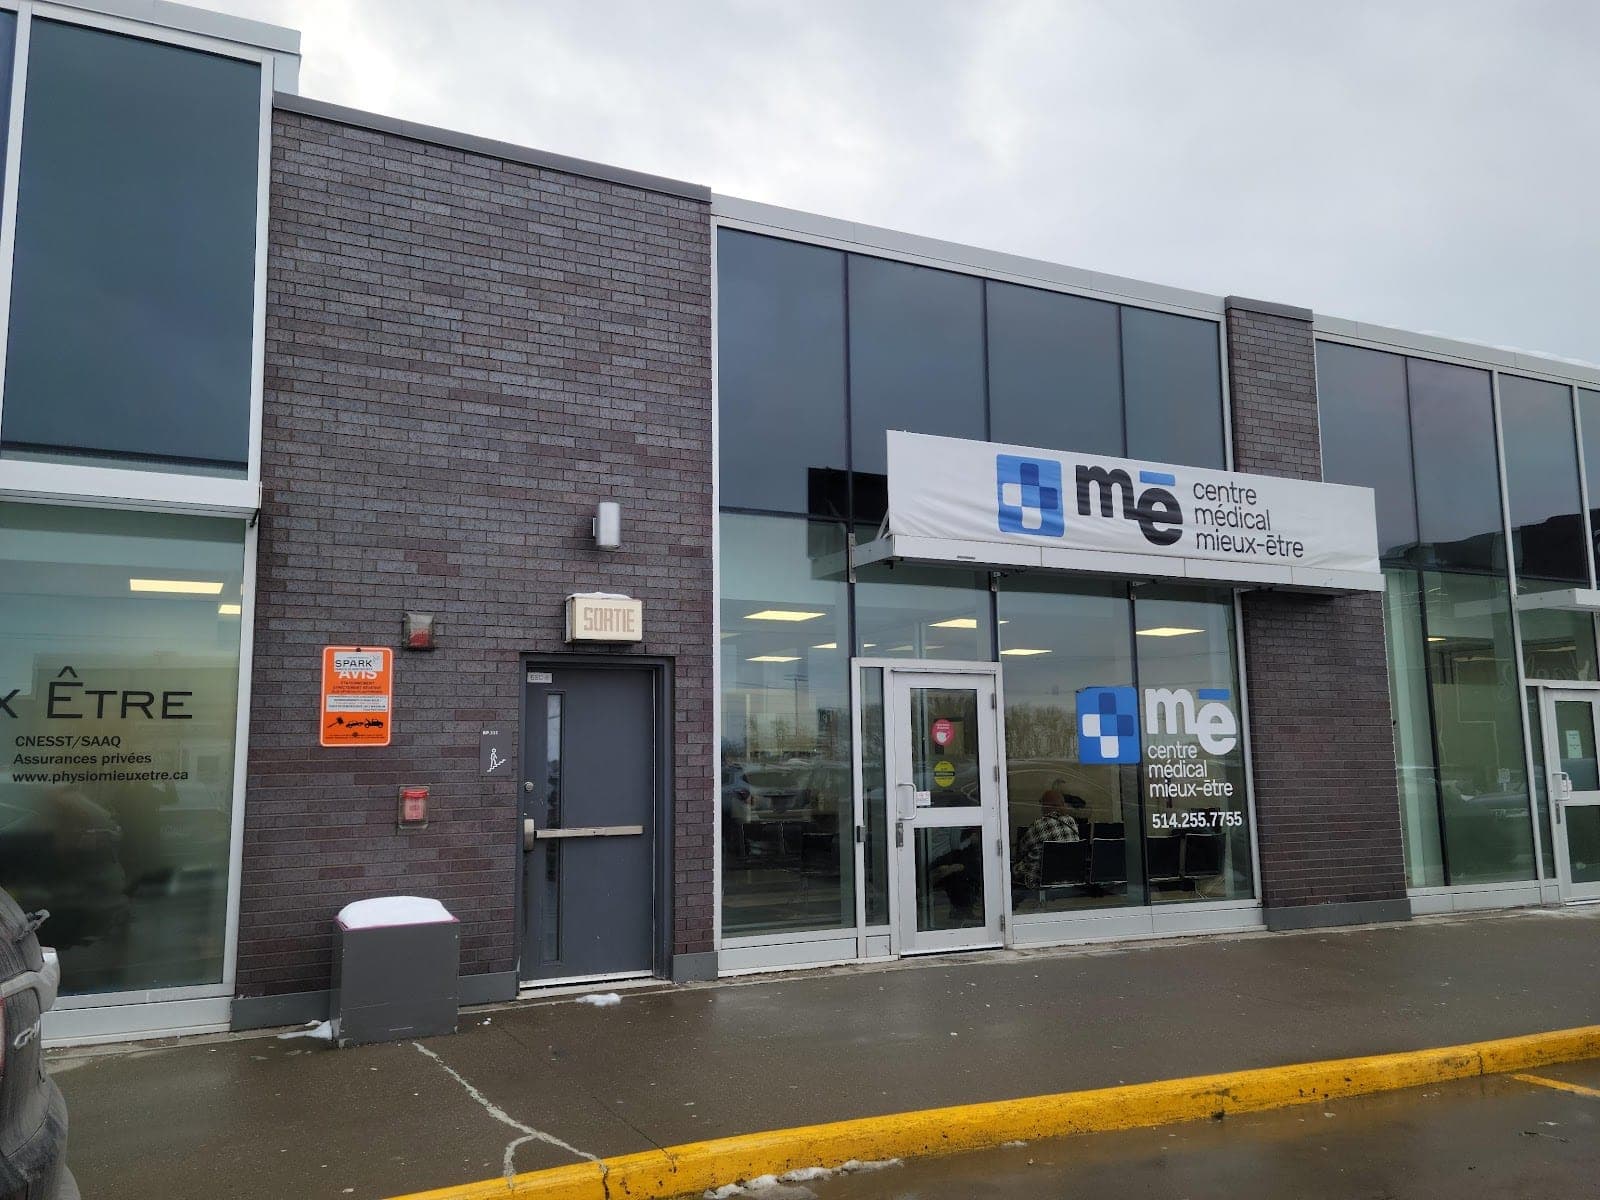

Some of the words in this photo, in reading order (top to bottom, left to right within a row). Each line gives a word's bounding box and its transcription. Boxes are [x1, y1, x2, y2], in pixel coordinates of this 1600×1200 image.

[1193, 481, 1257, 506] centre
[1194, 504, 1271, 532] médical
[583, 606, 635, 632] SORTIE
[335, 659, 372, 668] SPARK
[338, 670, 378, 679] AVIS
[47, 665, 193, 720] ÊTRE
[15, 735, 121, 750] CNESST/SAAQ
[1147, 741, 1198, 759] centre
[13, 753, 97, 765] Assurances
[101, 752, 152, 765] privées
[13, 770, 189, 784] www.physiomieuxetre.ca
[1148, 760, 1208, 779] médical
[1152, 811, 1243, 829] 514.255.7755
